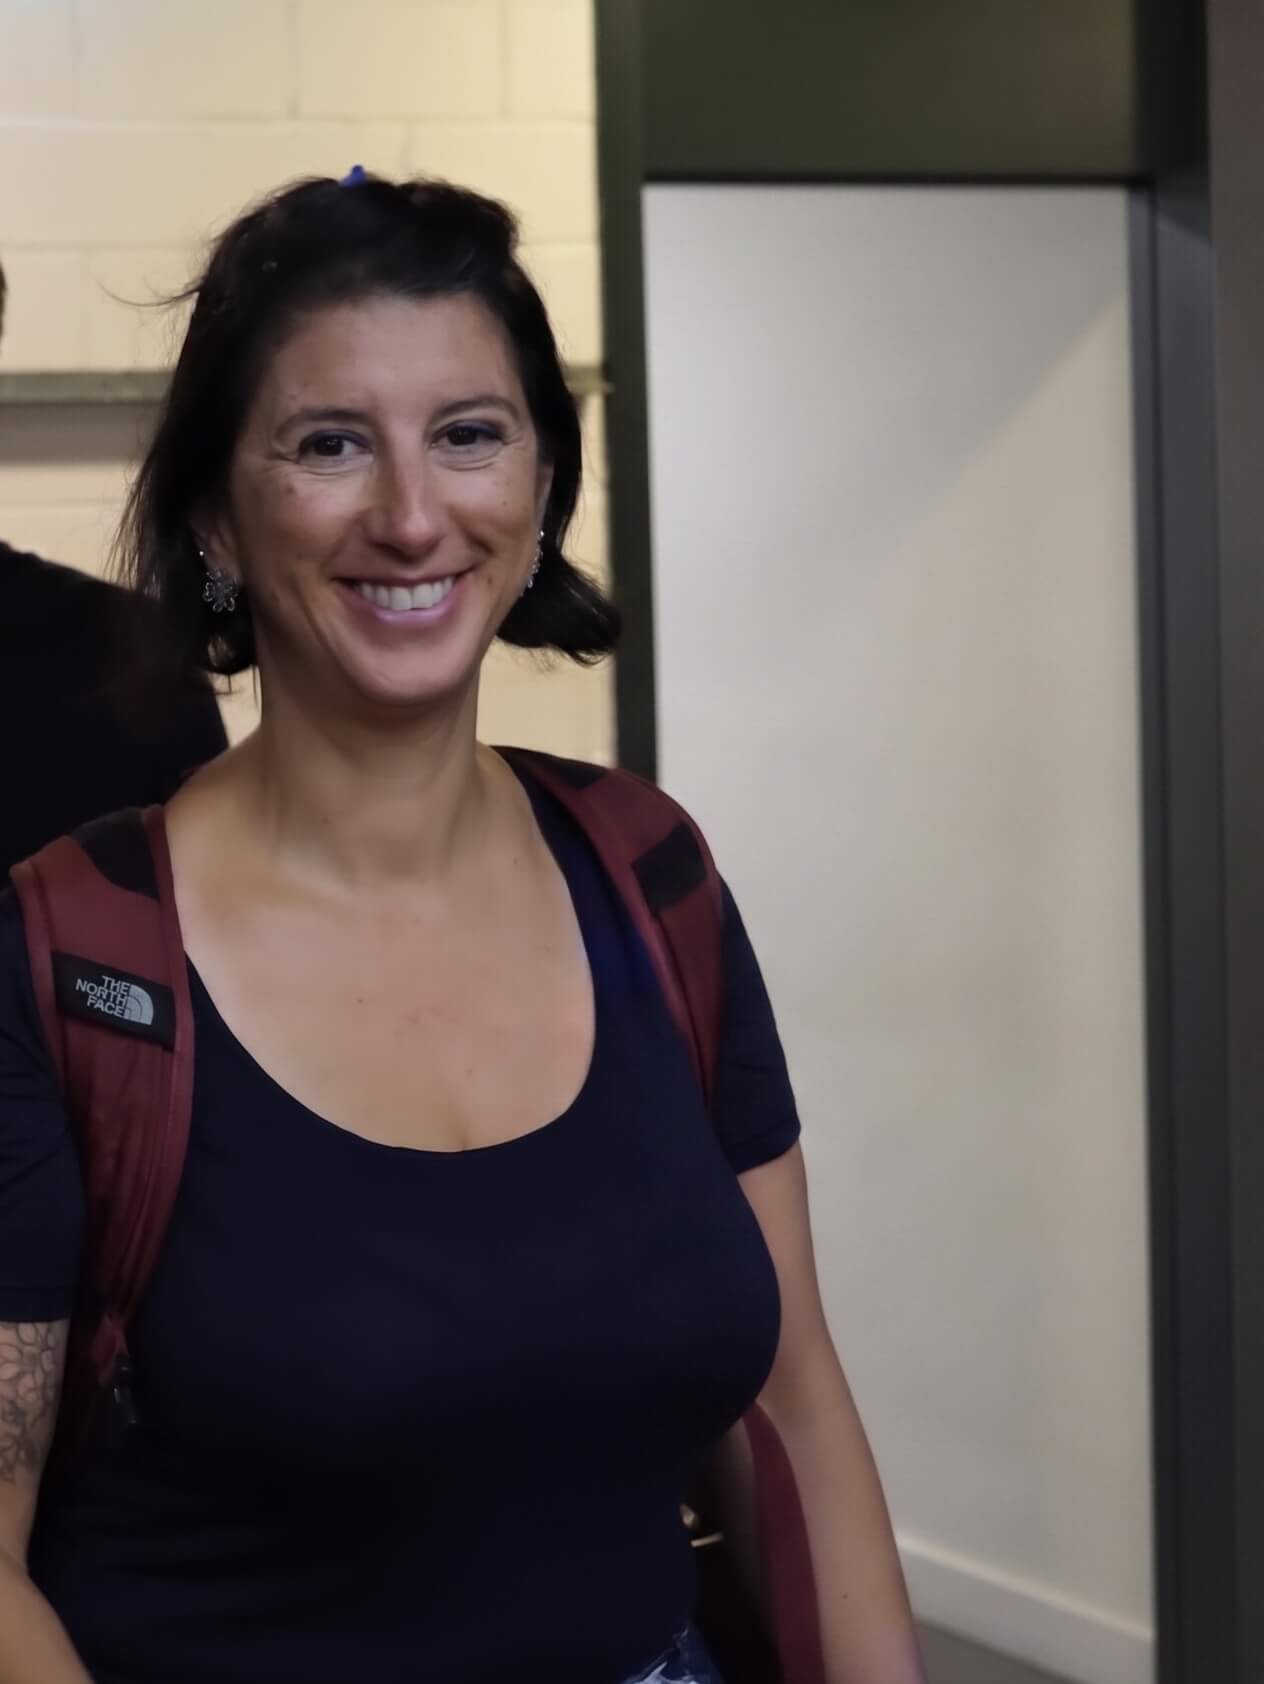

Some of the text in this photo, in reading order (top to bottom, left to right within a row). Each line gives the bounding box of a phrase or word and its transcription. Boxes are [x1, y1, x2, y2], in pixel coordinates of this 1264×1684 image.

[75, 978, 127, 1006] NORTH
[102, 975, 130, 995] THE
[87, 995, 125, 1018] FACE
